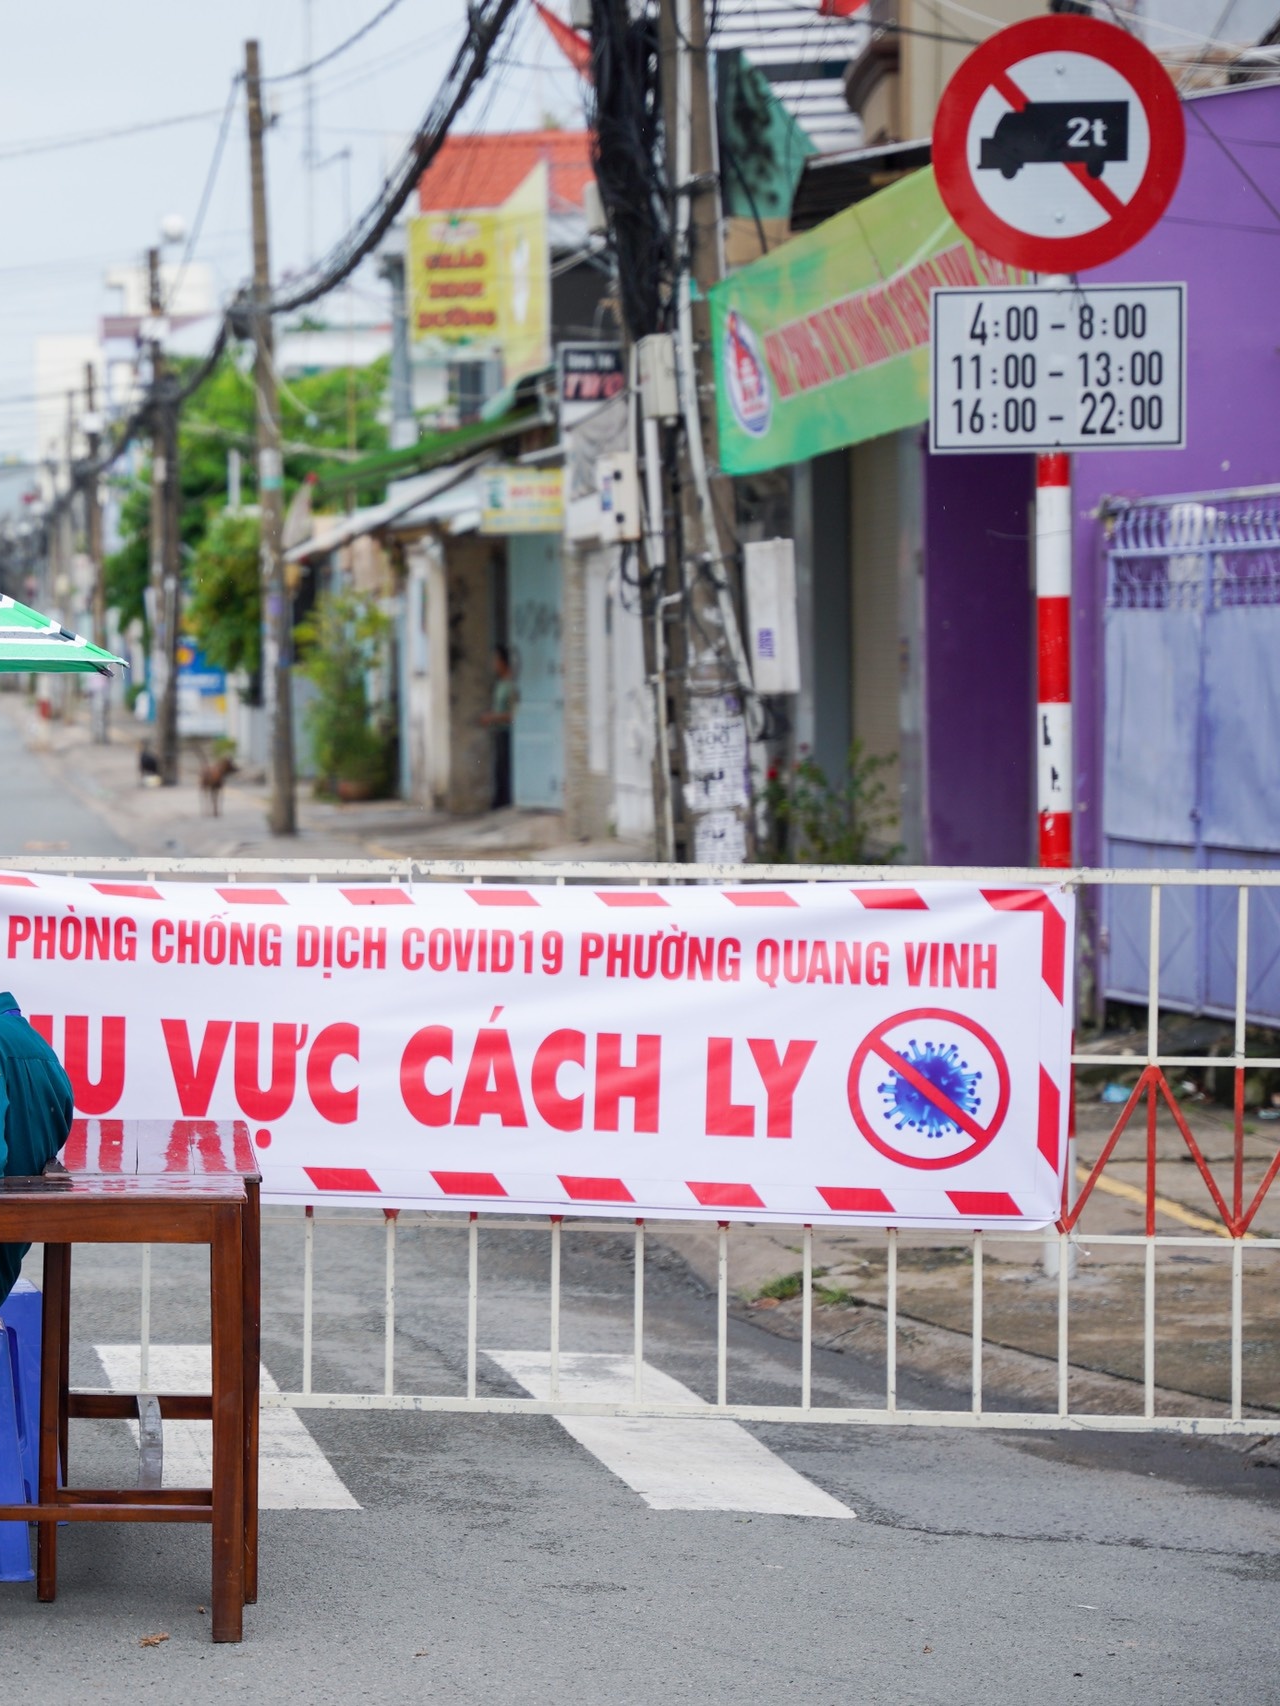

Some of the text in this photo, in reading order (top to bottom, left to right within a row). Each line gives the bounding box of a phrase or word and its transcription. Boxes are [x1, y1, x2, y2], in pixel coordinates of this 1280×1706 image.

[1066, 116, 1108, 147] 2t
[969, 302, 1038, 346] 4:00
[1079, 303, 1146, 340] 8:00
[952, 353, 1036, 390] 11:00
[1078, 350, 1163, 387] 13:00
[952, 397, 1036, 434] 16:00
[1080, 391, 1163, 435] 22:00
[7, 904, 138, 961] PHÒNG
[151, 911, 282, 968] CHỐNG
[296, 925, 387, 979] DỊCH
[401, 927, 563, 976] COVID19
[579, 924, 742, 982] PHƯỜNG
[755, 937, 889, 988] QUANG
[904, 942, 997, 990] VINH
[160, 1018, 360, 1149] VỰC
[399, 1004, 662, 1134] CÁCH
[704, 1036, 817, 1139] LY
